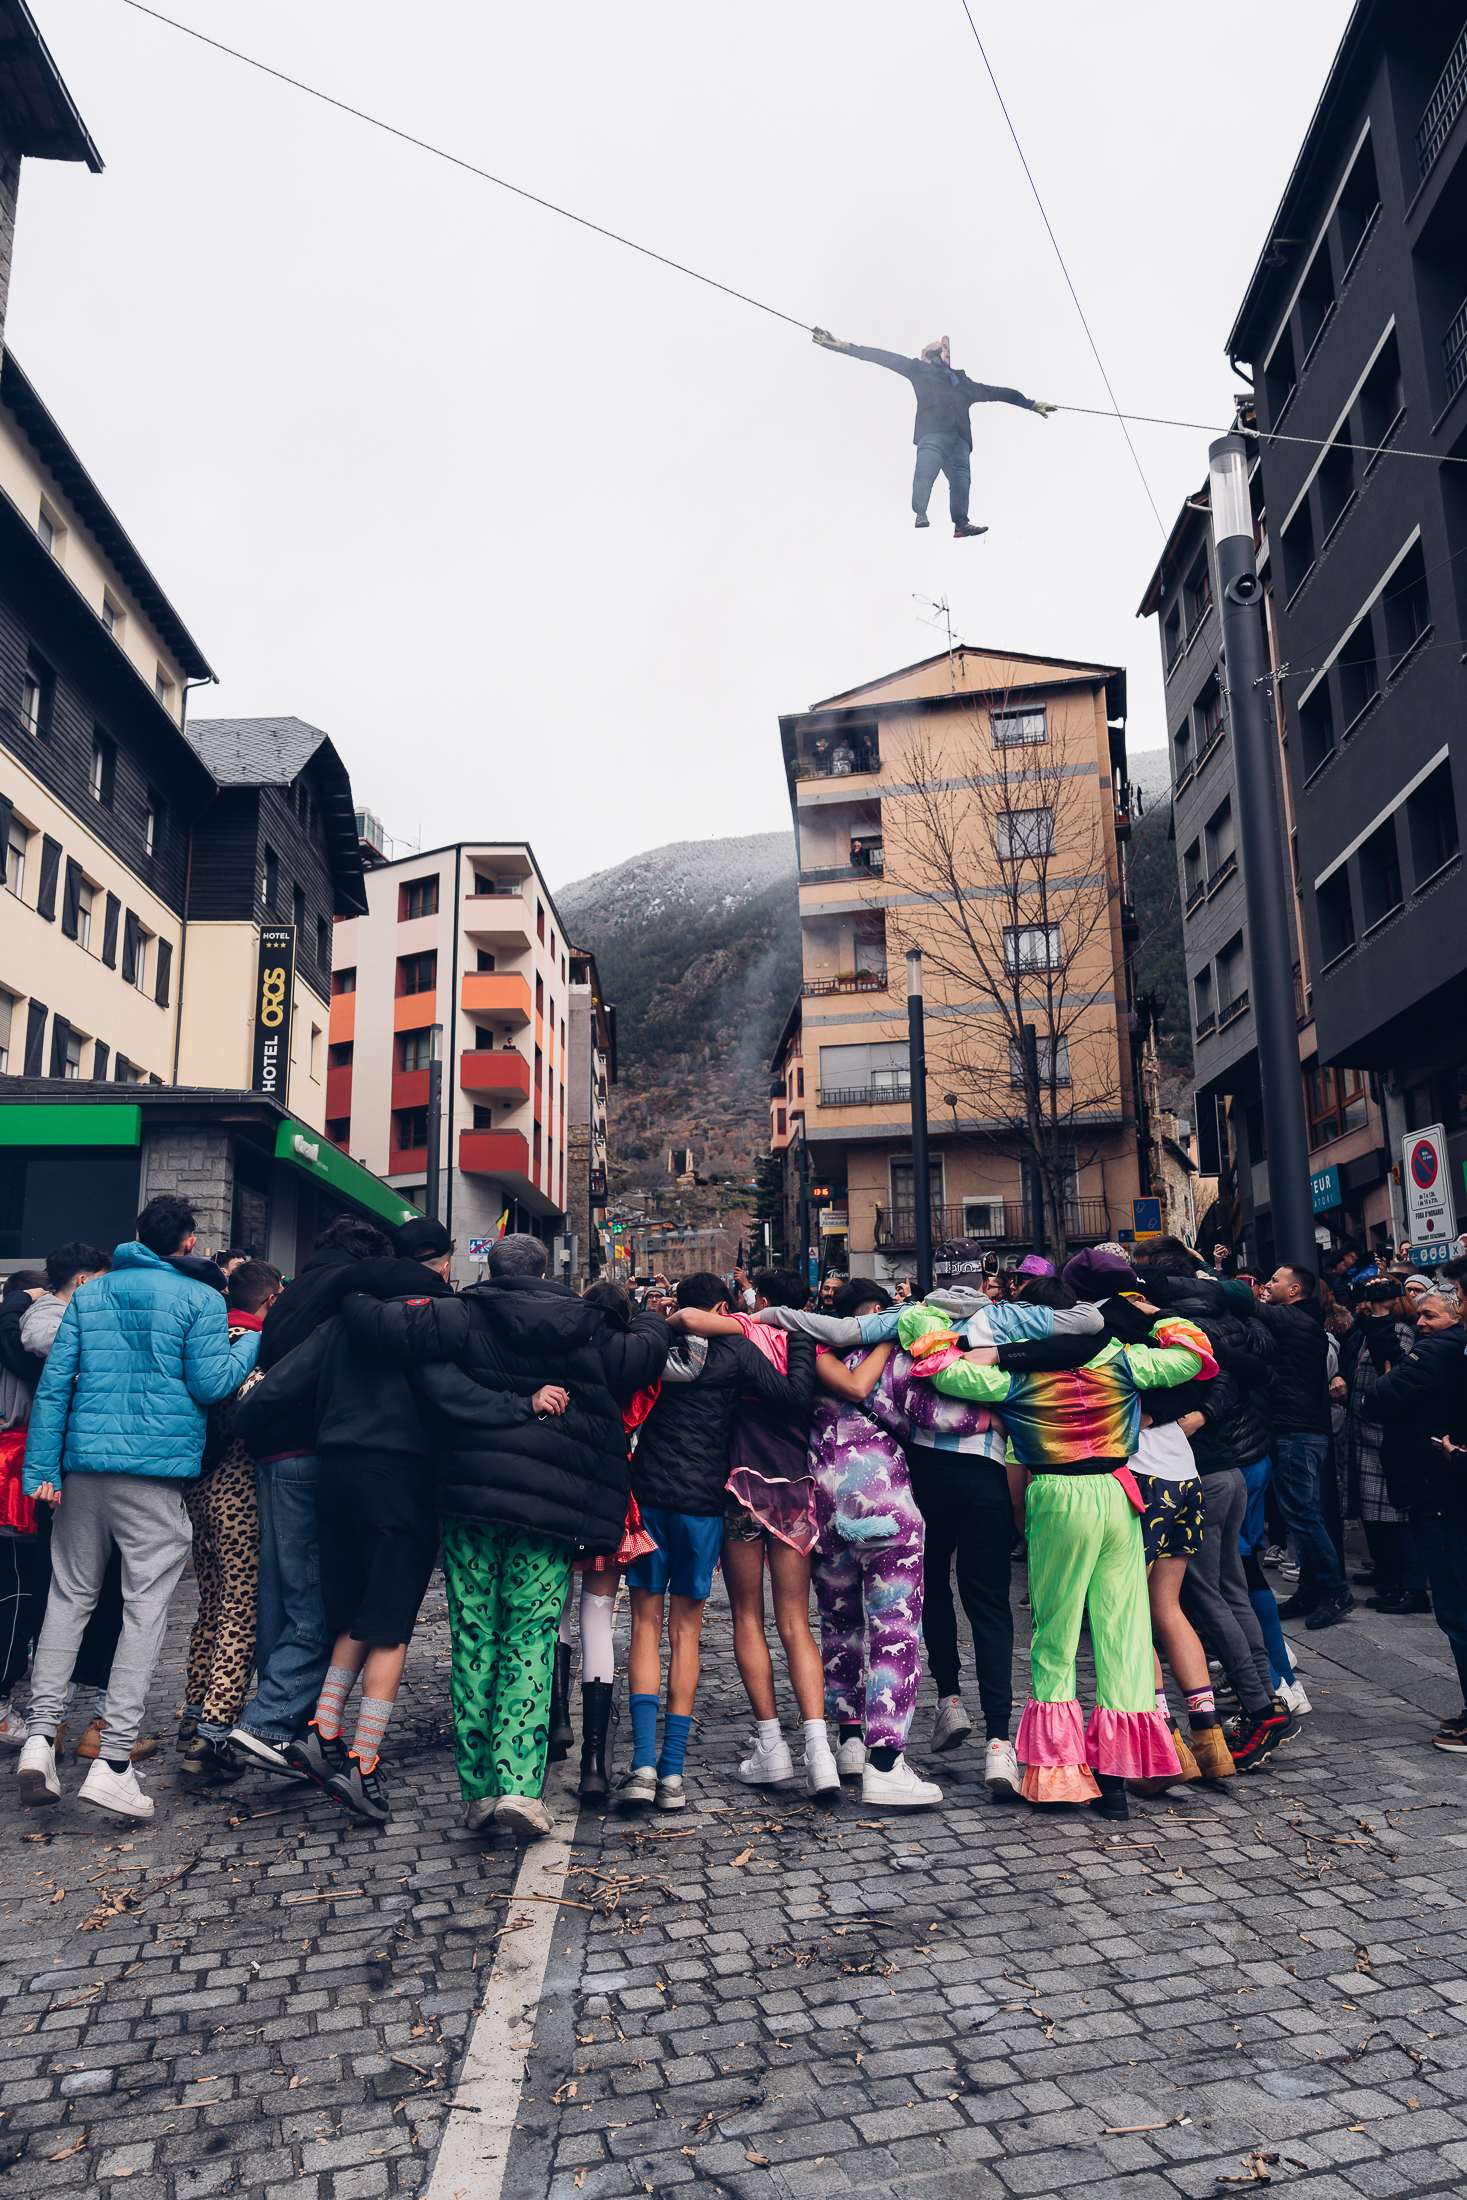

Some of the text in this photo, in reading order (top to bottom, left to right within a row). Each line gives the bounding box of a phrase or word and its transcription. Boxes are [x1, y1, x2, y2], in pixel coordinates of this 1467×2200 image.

[262, 932, 290, 940] HOTEL
[261, 967, 286, 1092] HOTEL OROS
[1310, 1174, 1332, 1194] EUR
